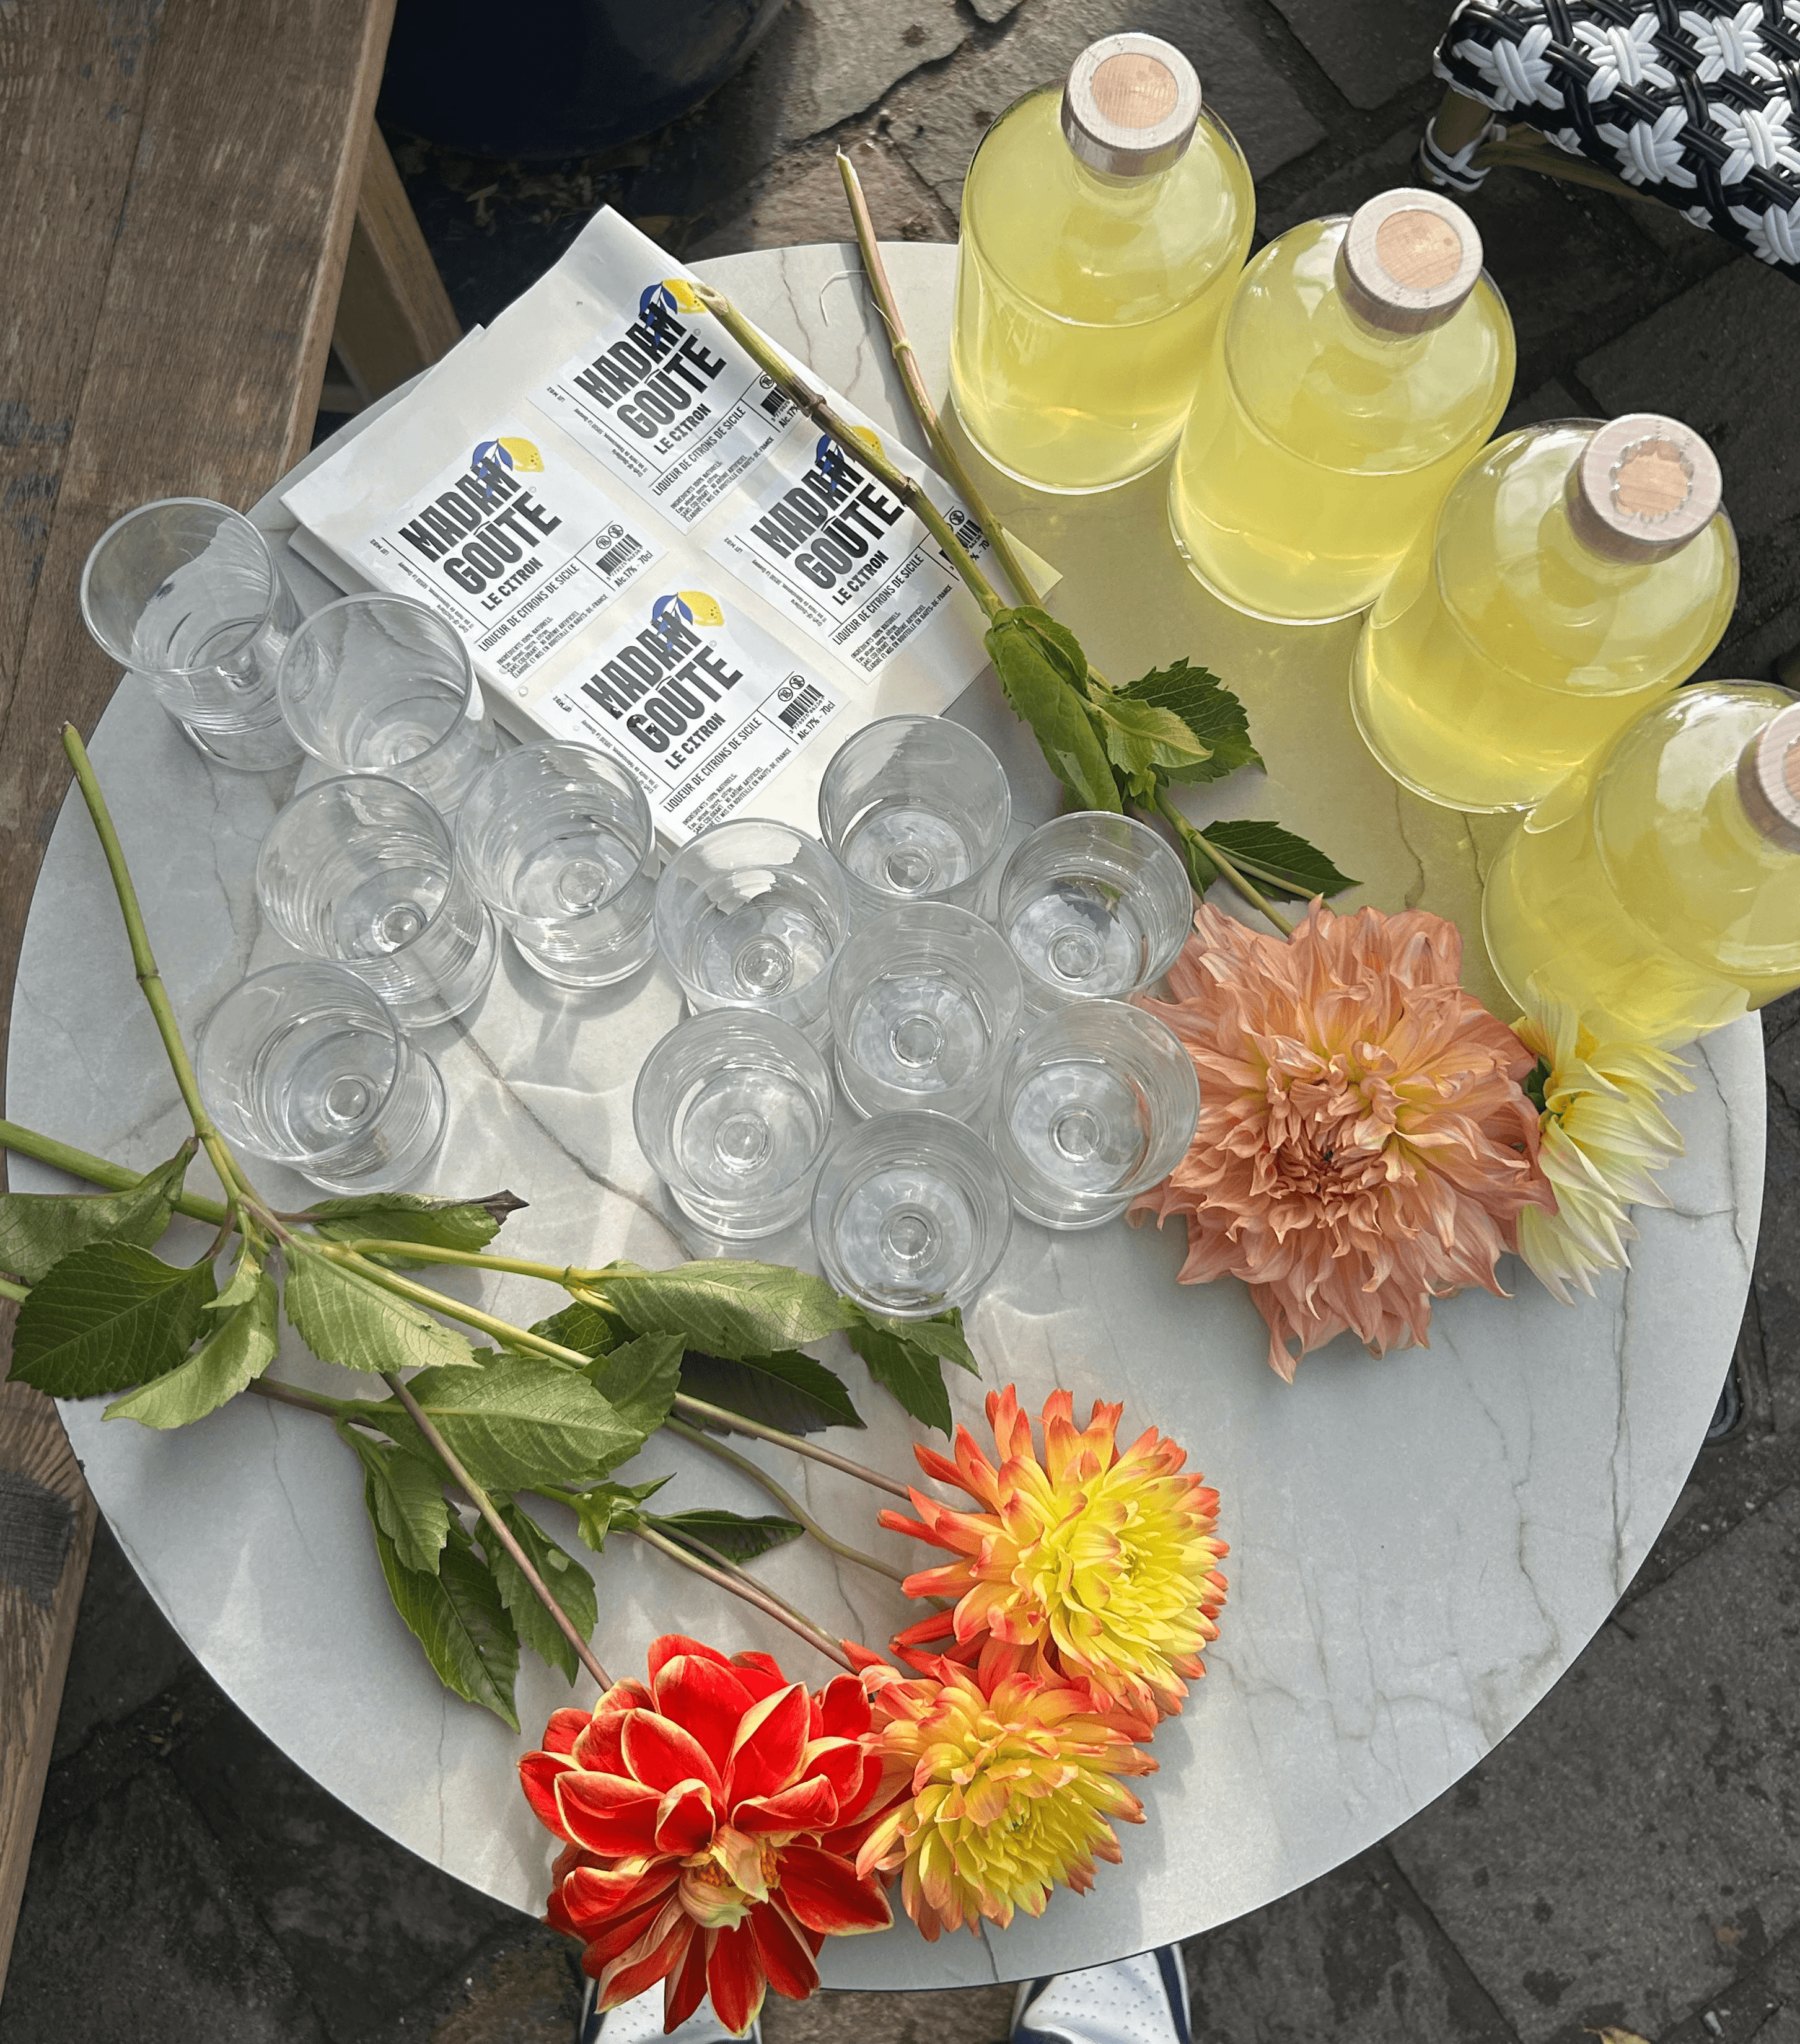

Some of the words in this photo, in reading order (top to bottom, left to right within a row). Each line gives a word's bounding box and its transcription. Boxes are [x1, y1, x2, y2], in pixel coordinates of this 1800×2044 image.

[573, 299, 687, 409] MADAM
[617, 330, 727, 439] GOÛTE
[652, 436, 674, 455] LE
[669, 402, 711, 441] CITRON
[687, 435, 718, 462] CITRONS
[713, 426, 727, 439] DE
[719, 405, 746, 430] SICILE
[651, 467, 683, 496] LIQUEUR
[678, 458, 692, 471] DE
[397, 456, 522, 563] MADAM
[749, 448, 865, 559] MADAM
[794, 482, 905, 589] GOÛTE
[442, 490, 563, 594] GOÛTE
[613, 565, 638, 588] Alc.17%
[636, 550, 653, 565] 70cl
[832, 587, 853, 606] LE
[846, 549, 889, 592] CITRON
[477, 623, 511, 651] LIQUEUR
[506, 614, 521, 627] DE
[516, 590, 548, 618] CITRONS
[544, 581, 559, 594] DE
[554, 563, 580, 585] SICILE
[480, 592, 503, 611] LE
[497, 556, 543, 597] CITRON
[832, 618, 862, 645] LIQUEUR
[857, 609, 871, 622] DE
[866, 584, 895, 614] CITRONS
[890, 574, 905, 588] DE
[900, 553, 924, 578] SICILE
[579, 610, 703, 720] MADAM
[626, 645, 744, 753] GOÛTE
[664, 749, 687, 770] LE
[680, 711, 726, 754] CITRON
[796, 716, 820, 740] Alc.17%
[819, 700, 836, 715] 70cl
[662, 783, 695, 813] LIQUEUR
[690, 773, 705, 786] DE
[700, 746, 732, 776] CITRONS
[727, 737, 742, 750] DE
[737, 716, 762, 740] SICILE
